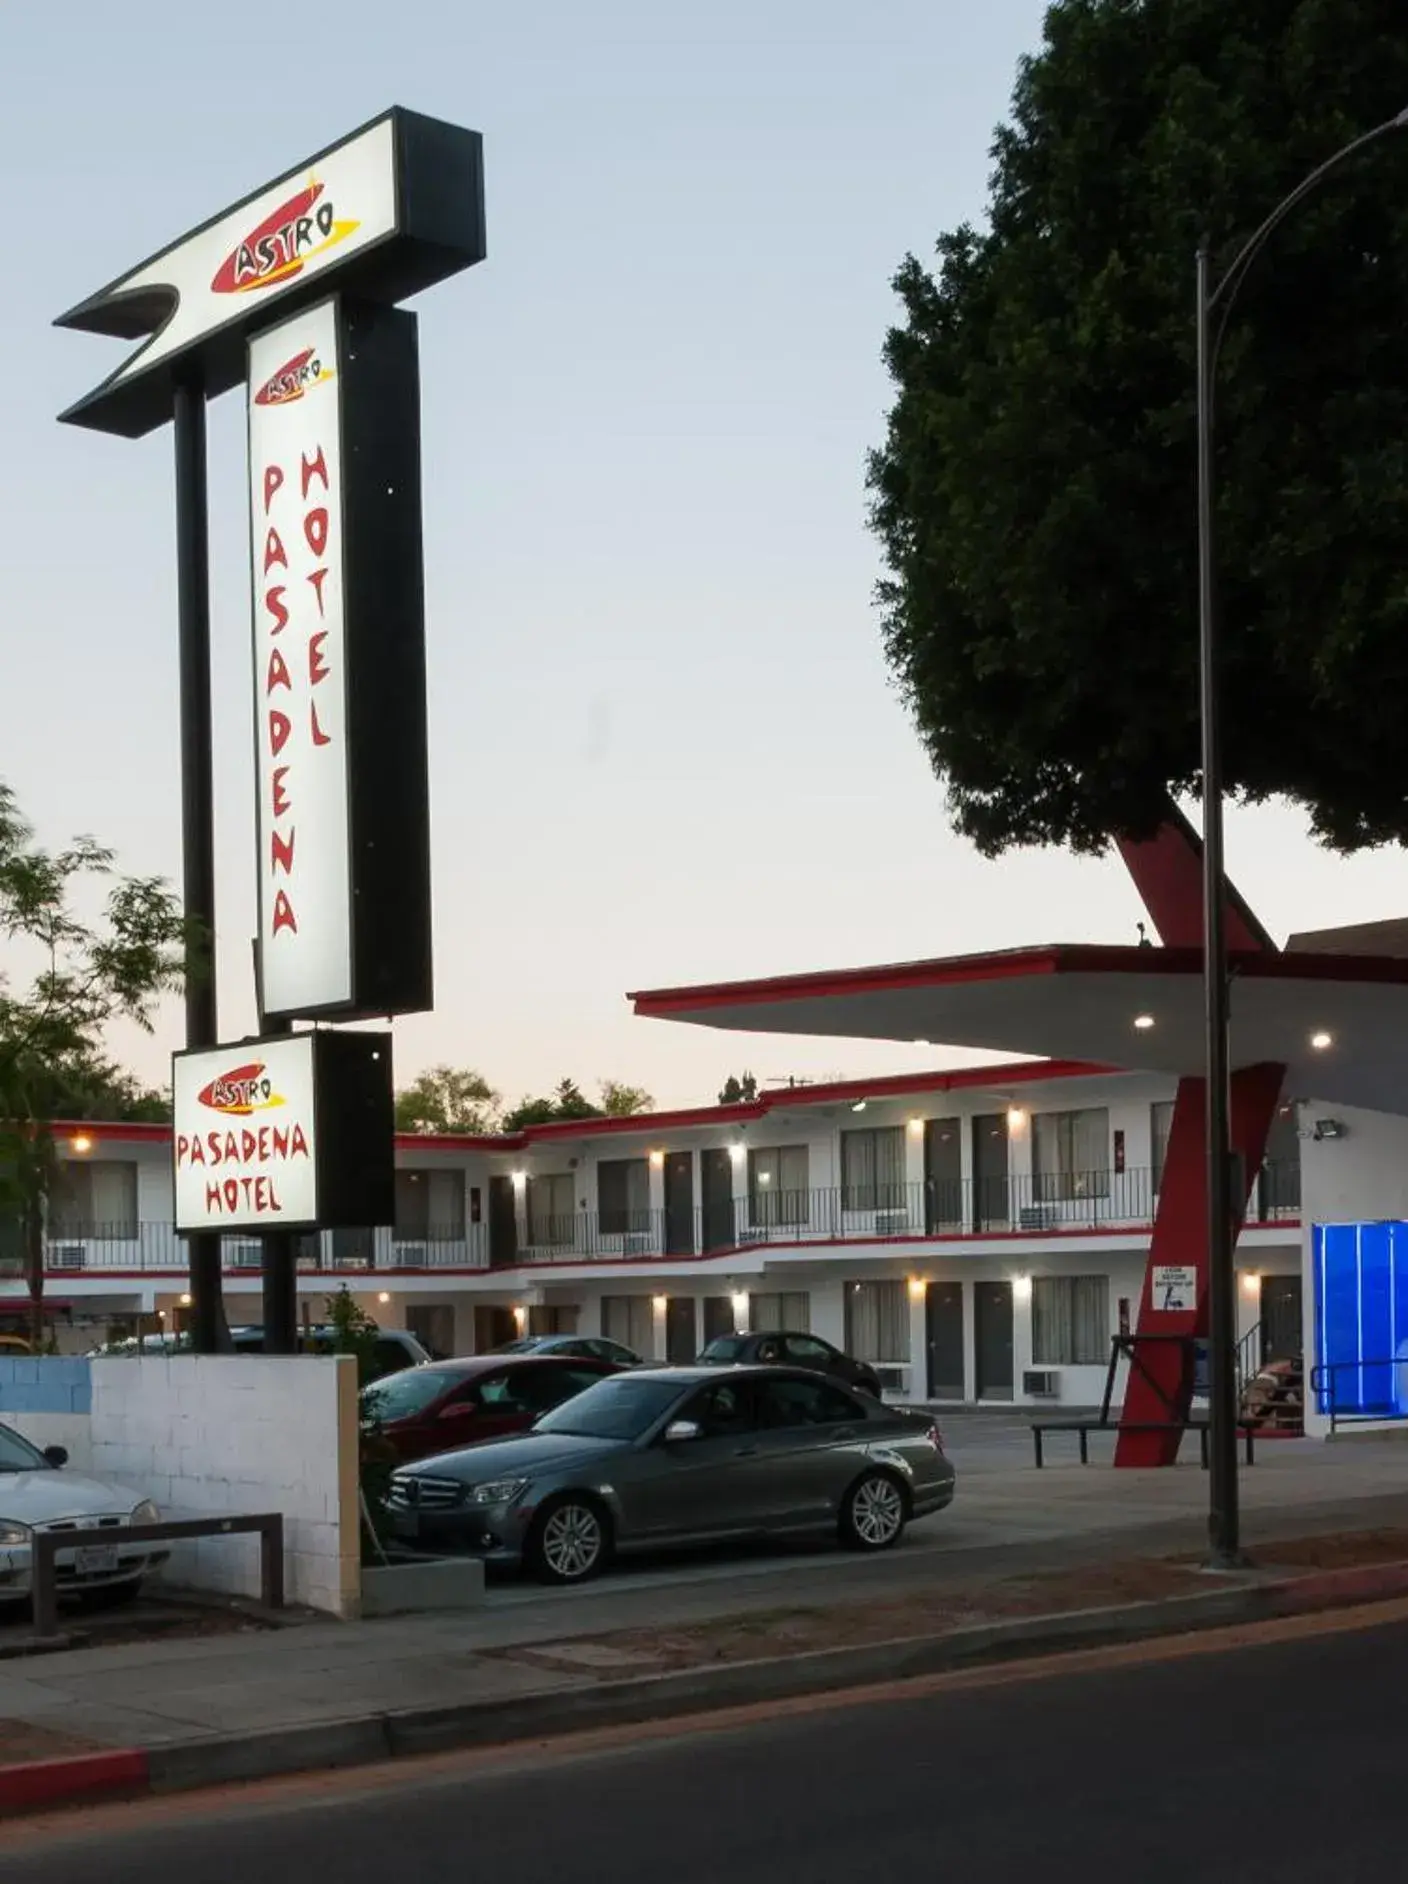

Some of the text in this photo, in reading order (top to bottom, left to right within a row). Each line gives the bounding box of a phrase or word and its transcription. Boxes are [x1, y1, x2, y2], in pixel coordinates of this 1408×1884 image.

[234, 203, 333, 282] ASTRO
[268, 359, 321, 401] ASTRO
[301, 444, 330, 746] HOTEL
[264, 465, 297, 936] PASADENA
[212, 1078, 271, 1104] ASTRO
[177, 1121, 309, 1167] PASADENA
[206, 1176, 282, 1214] HOTEL
